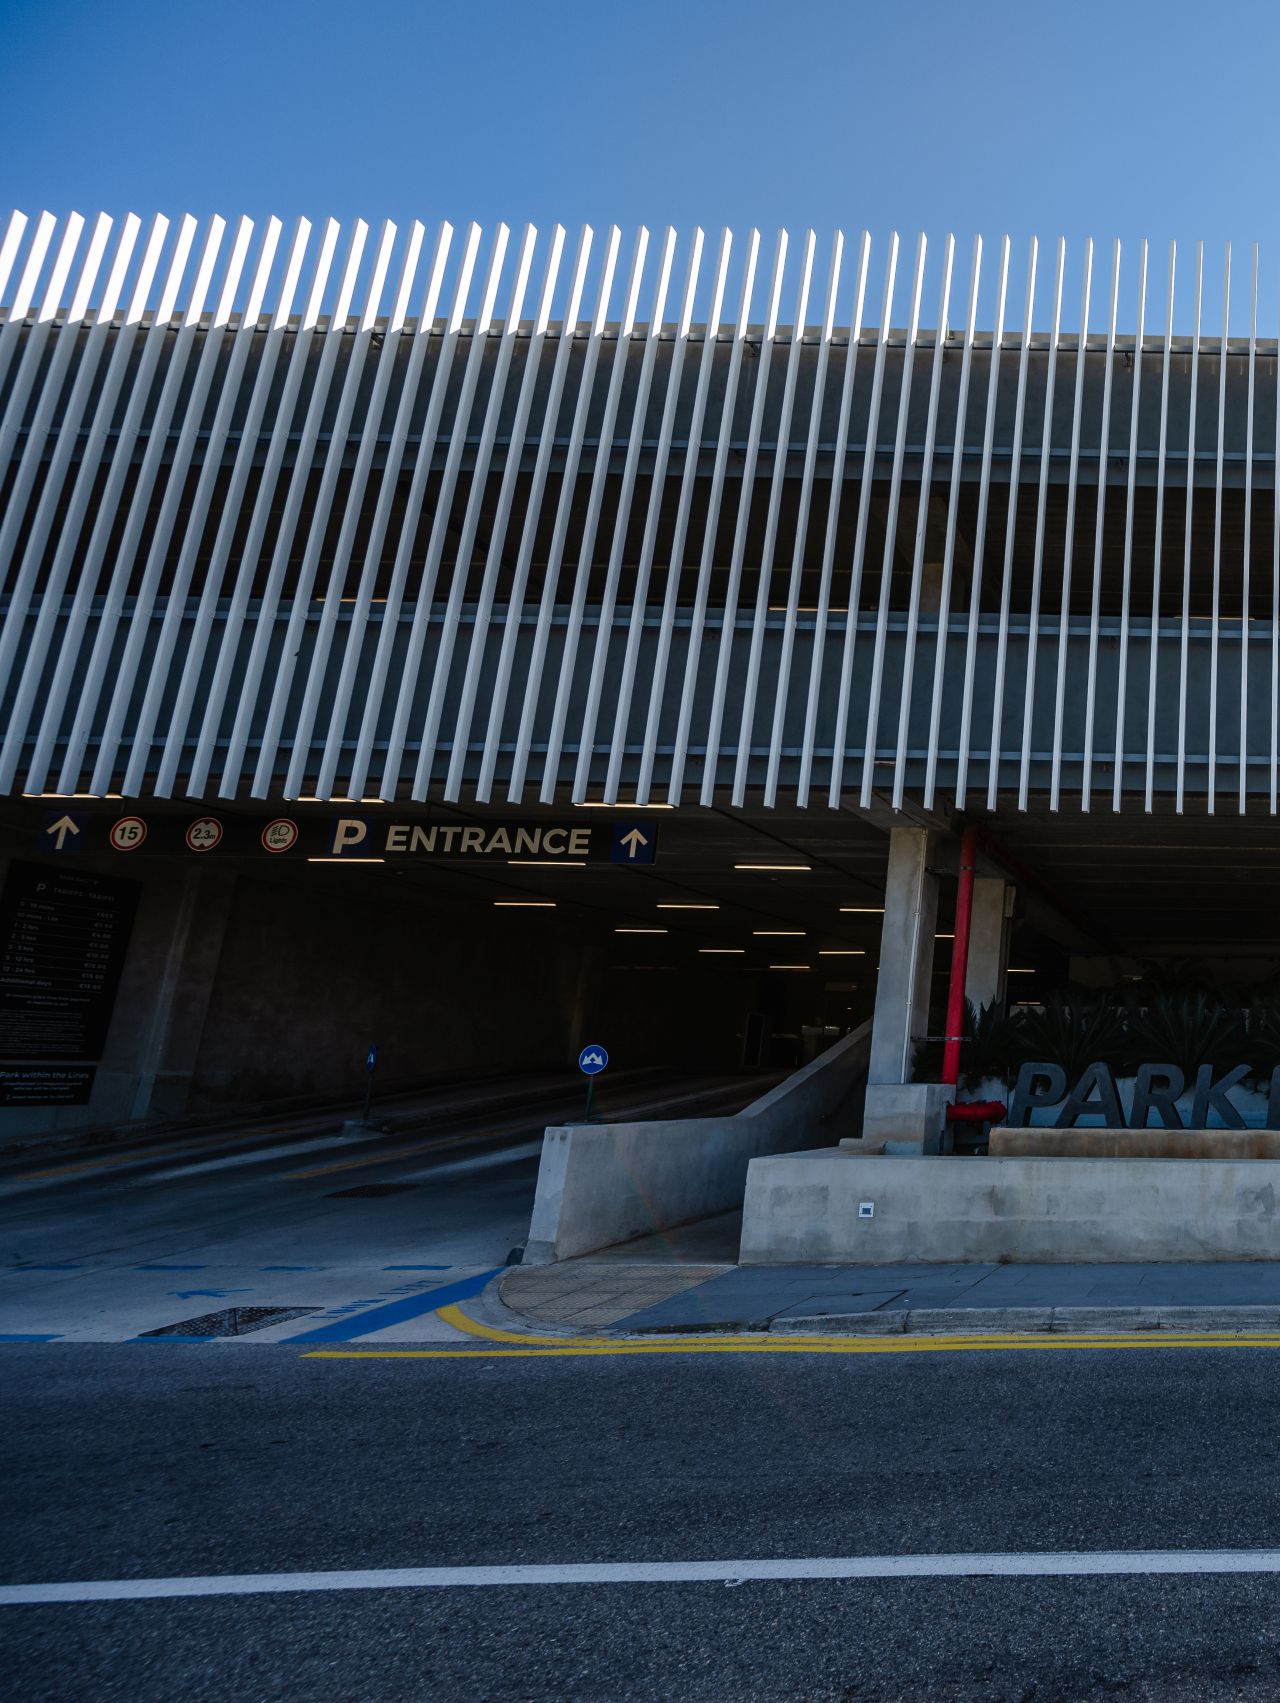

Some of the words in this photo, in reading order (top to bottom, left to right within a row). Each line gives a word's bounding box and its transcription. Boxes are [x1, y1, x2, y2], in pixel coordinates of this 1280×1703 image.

[119, 826, 140, 841] 15
[193, 827, 216, 840] 2.3m
[332, 819, 367, 855] P
[386, 825, 591, 856] ENTRANCE
[269, 837, 288, 846] Lights
